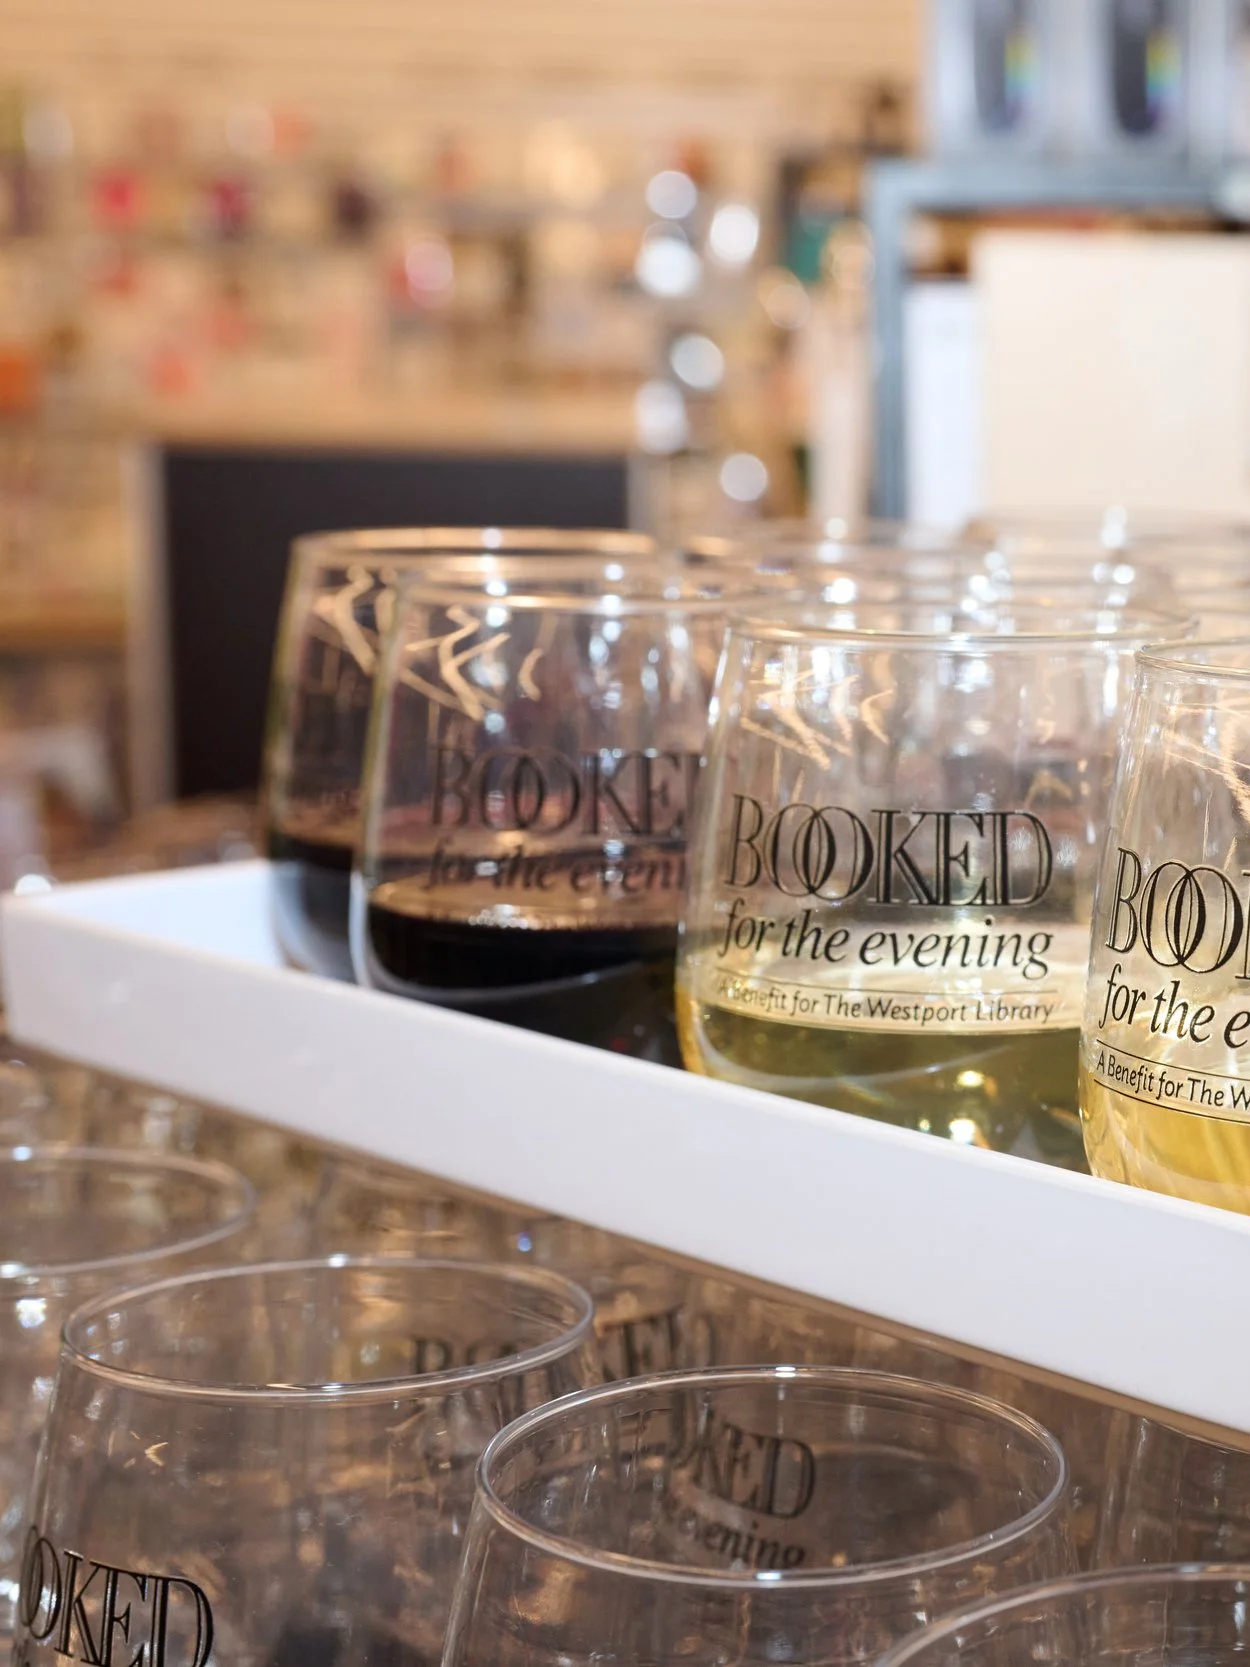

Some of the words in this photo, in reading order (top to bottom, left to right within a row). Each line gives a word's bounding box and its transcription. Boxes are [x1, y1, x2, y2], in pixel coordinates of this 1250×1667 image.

[432, 746, 702, 836] BOOKE
[723, 793, 1053, 907] BOOKED
[718, 898, 775, 957] for
[781, 909, 850, 964] the
[858, 917, 1054, 981] evening
[790, 989, 821, 1017] for
[824, 993, 862, 1019] The
[867, 998, 968, 1027] Westport
[976, 1000, 1055, 1023] Library
[1098, 962, 1147, 1030] for
[1150, 979, 1216, 1044] the
[1096, 1049, 1106, 1072] A
[1107, 1056, 1155, 1094] Benefit
[1155, 1070, 1185, 1101] for
[1187, 1077, 1225, 1108] The
